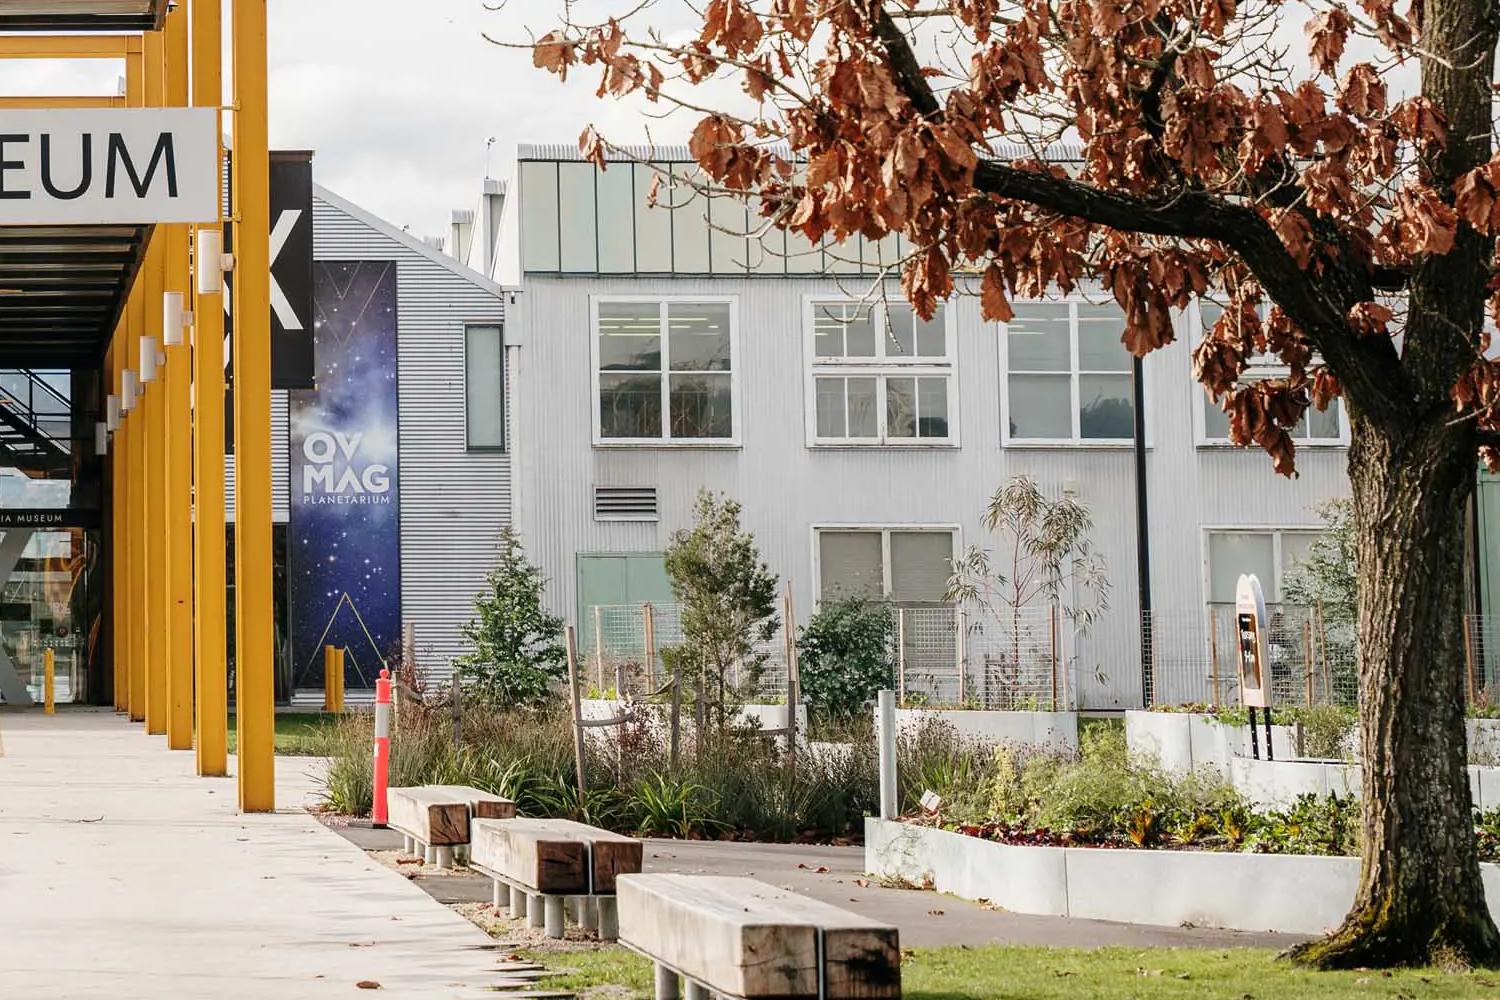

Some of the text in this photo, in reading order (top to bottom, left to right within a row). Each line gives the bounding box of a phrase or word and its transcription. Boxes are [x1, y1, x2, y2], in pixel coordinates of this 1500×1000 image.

[303, 465, 390, 493] MAG
[303, 496, 390, 504] PLANETARIUM
[17, 514, 63, 523] MUSEUM
